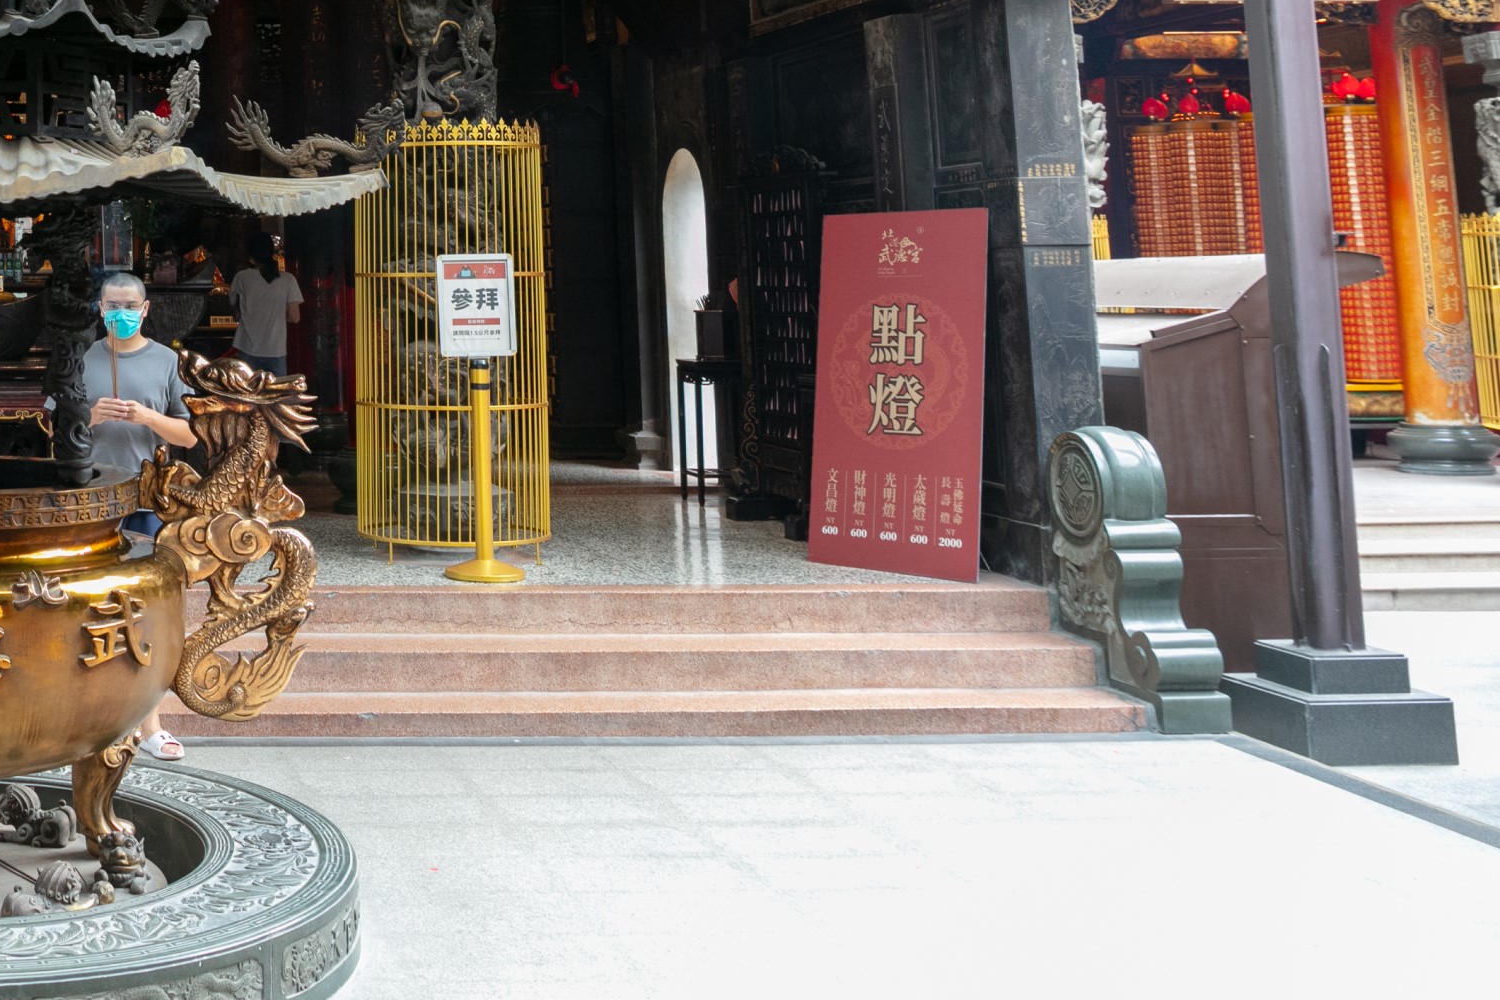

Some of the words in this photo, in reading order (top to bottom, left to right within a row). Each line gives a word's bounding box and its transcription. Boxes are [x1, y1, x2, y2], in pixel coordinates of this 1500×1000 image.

[450, 287, 499, 311] 參拜
[866, 302, 928, 436] 點燈
[825, 467, 839, 513] 文昌燈
[852, 469, 867, 516] 財神燈
[882, 471, 897, 519] 光明燈
[912, 473, 927, 522] 太歲燈
[854, 519, 864, 527] NT
[883, 522, 894, 530] NT
[914, 524, 924, 532] NT
[821, 525, 838, 535] 600
[850, 528, 867, 538] 600
[945, 528, 956, 536] NT
[880, 531, 897, 541] 600
[910, 534, 928, 545] 600
[938, 537, 963, 549] 2000
